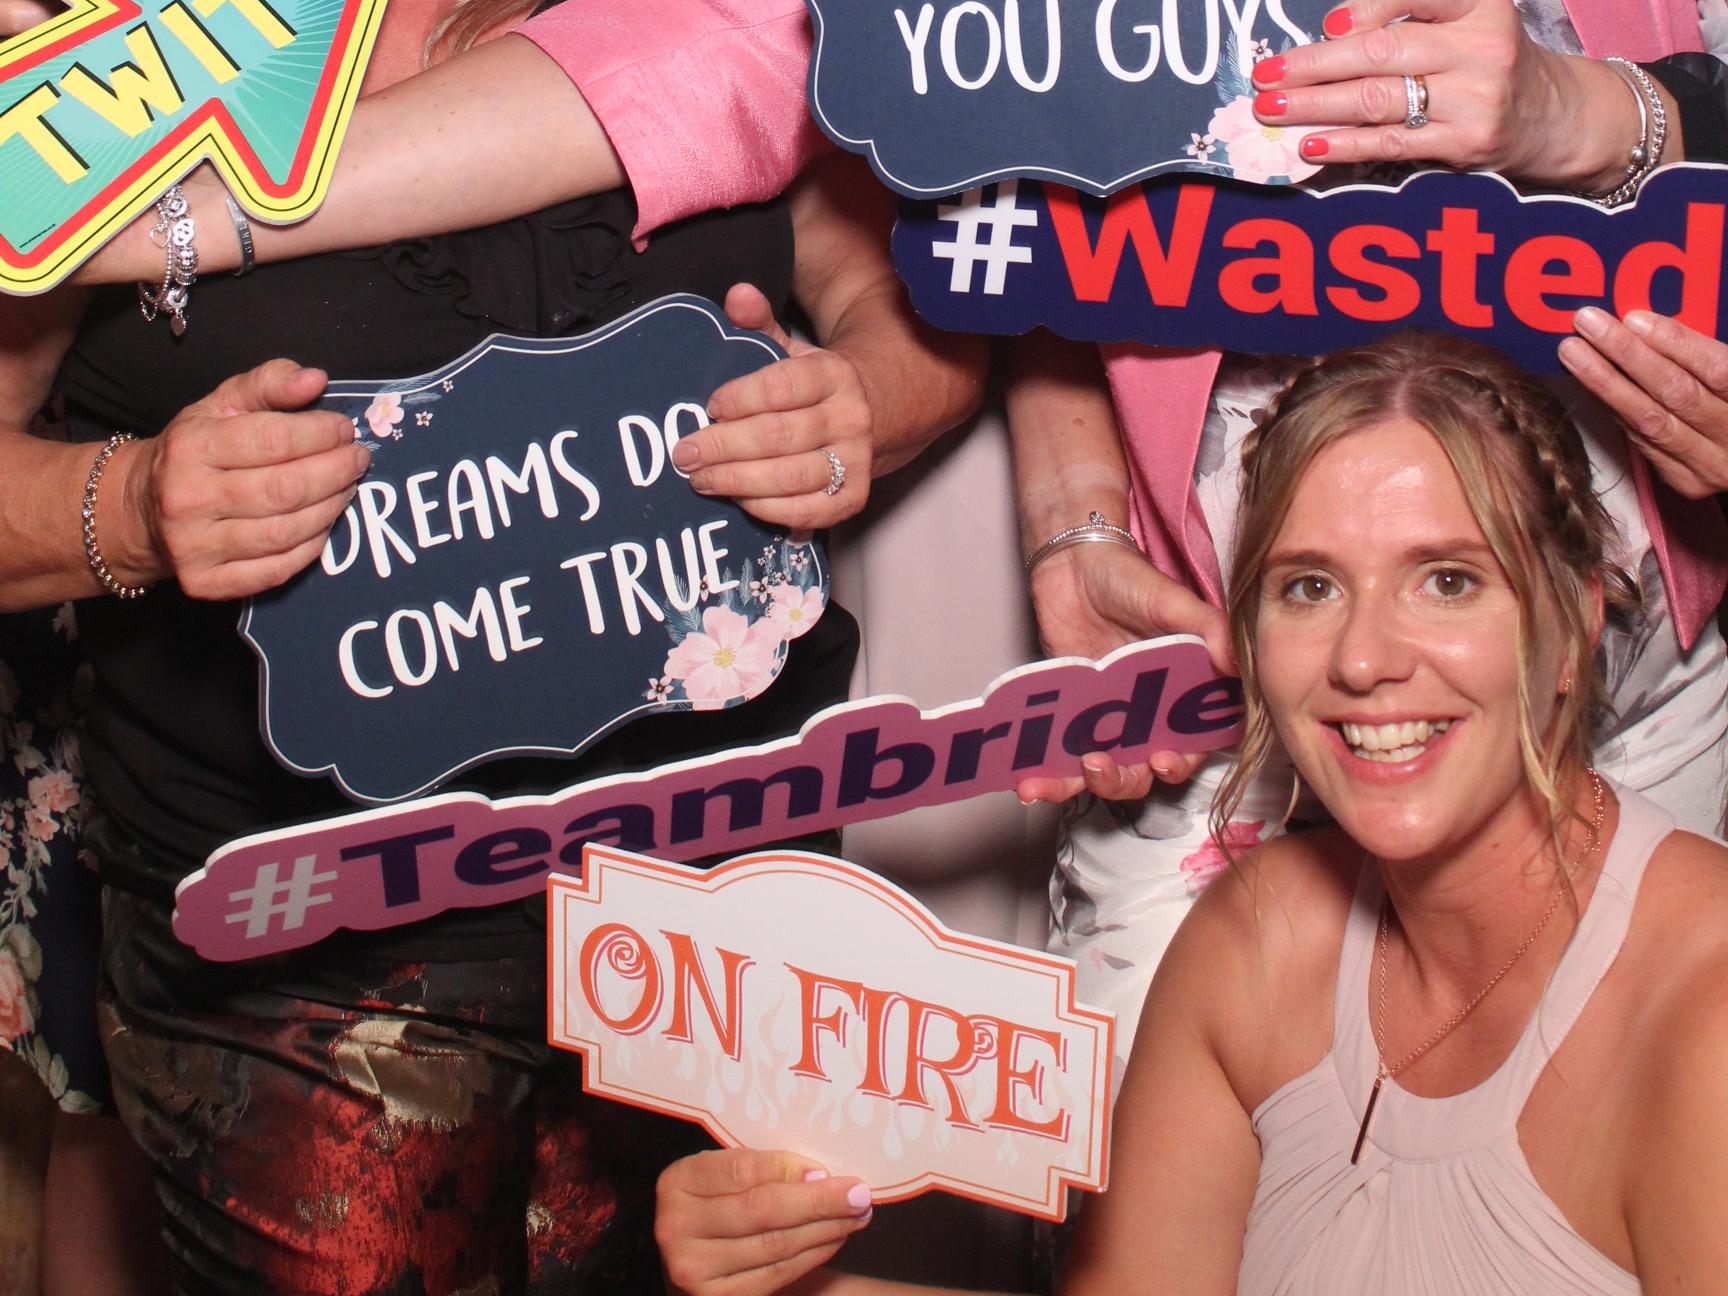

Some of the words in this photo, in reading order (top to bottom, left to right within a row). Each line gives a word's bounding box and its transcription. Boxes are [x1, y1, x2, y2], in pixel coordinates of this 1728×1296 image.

[932, 178, 1726, 338] #Wasted
[338, 575, 544, 698] COME
[560, 519, 740, 636] TRUE
[579, 922, 757, 1062] ON
[783, 961, 1071, 1144] FIRE
